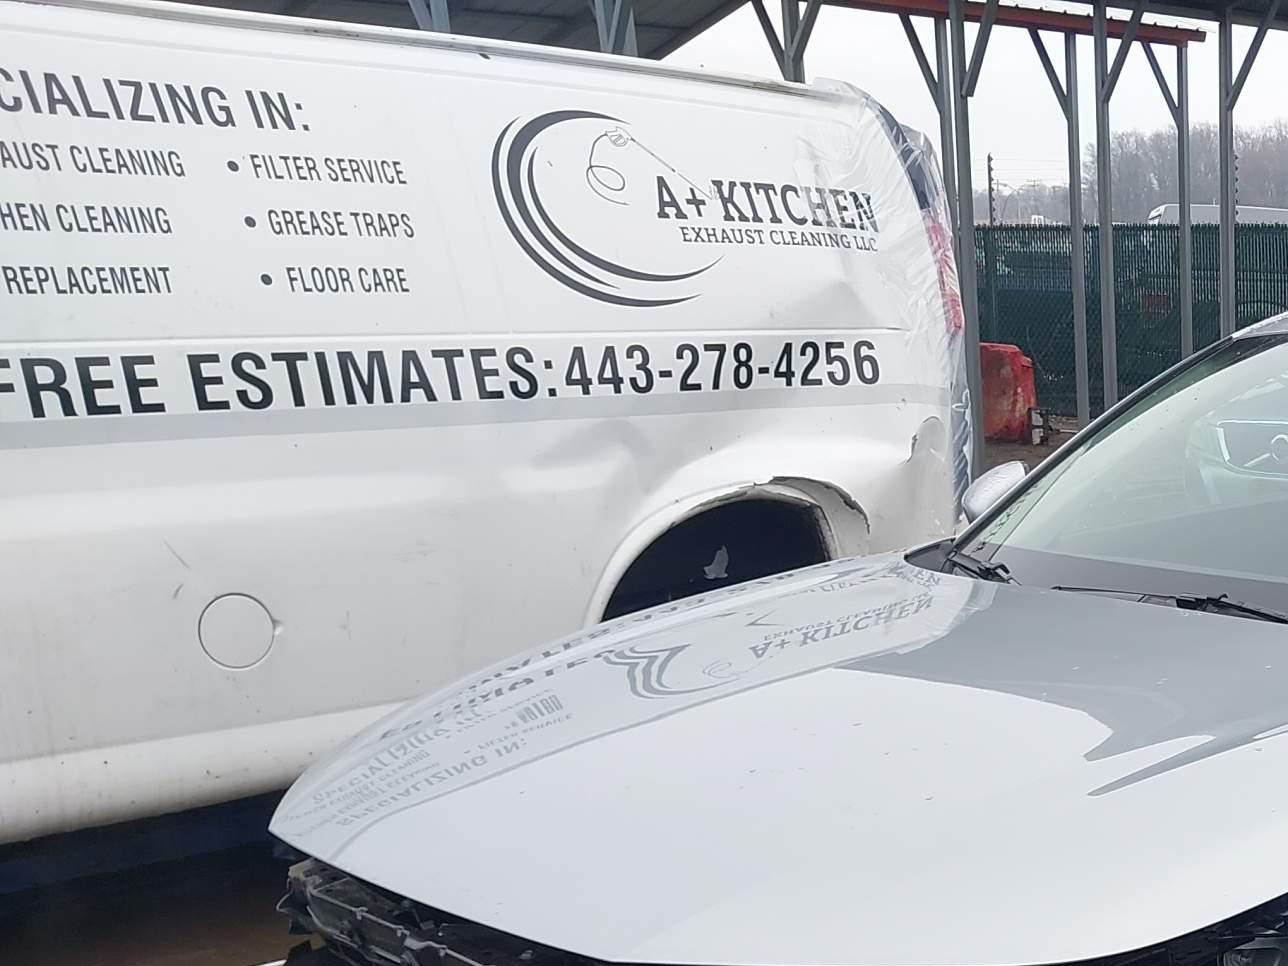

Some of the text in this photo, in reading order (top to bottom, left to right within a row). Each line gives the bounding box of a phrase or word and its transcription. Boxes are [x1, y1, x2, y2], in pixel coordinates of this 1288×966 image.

[0, 67, 310, 132] CIALIZING IN:
[70, 144, 186, 177] CLEANING
[249, 154, 407, 185] FILTER SERVICE
[56, 204, 173, 234] CLEANING
[267, 209, 415, 238] GREASE TRAPS
[679, 226, 878, 252] EXHAUST CLEANING LLC
[1, 265, 172, 295] REPLACEMENT
[286, 267, 410, 293] FLOOR CARE
